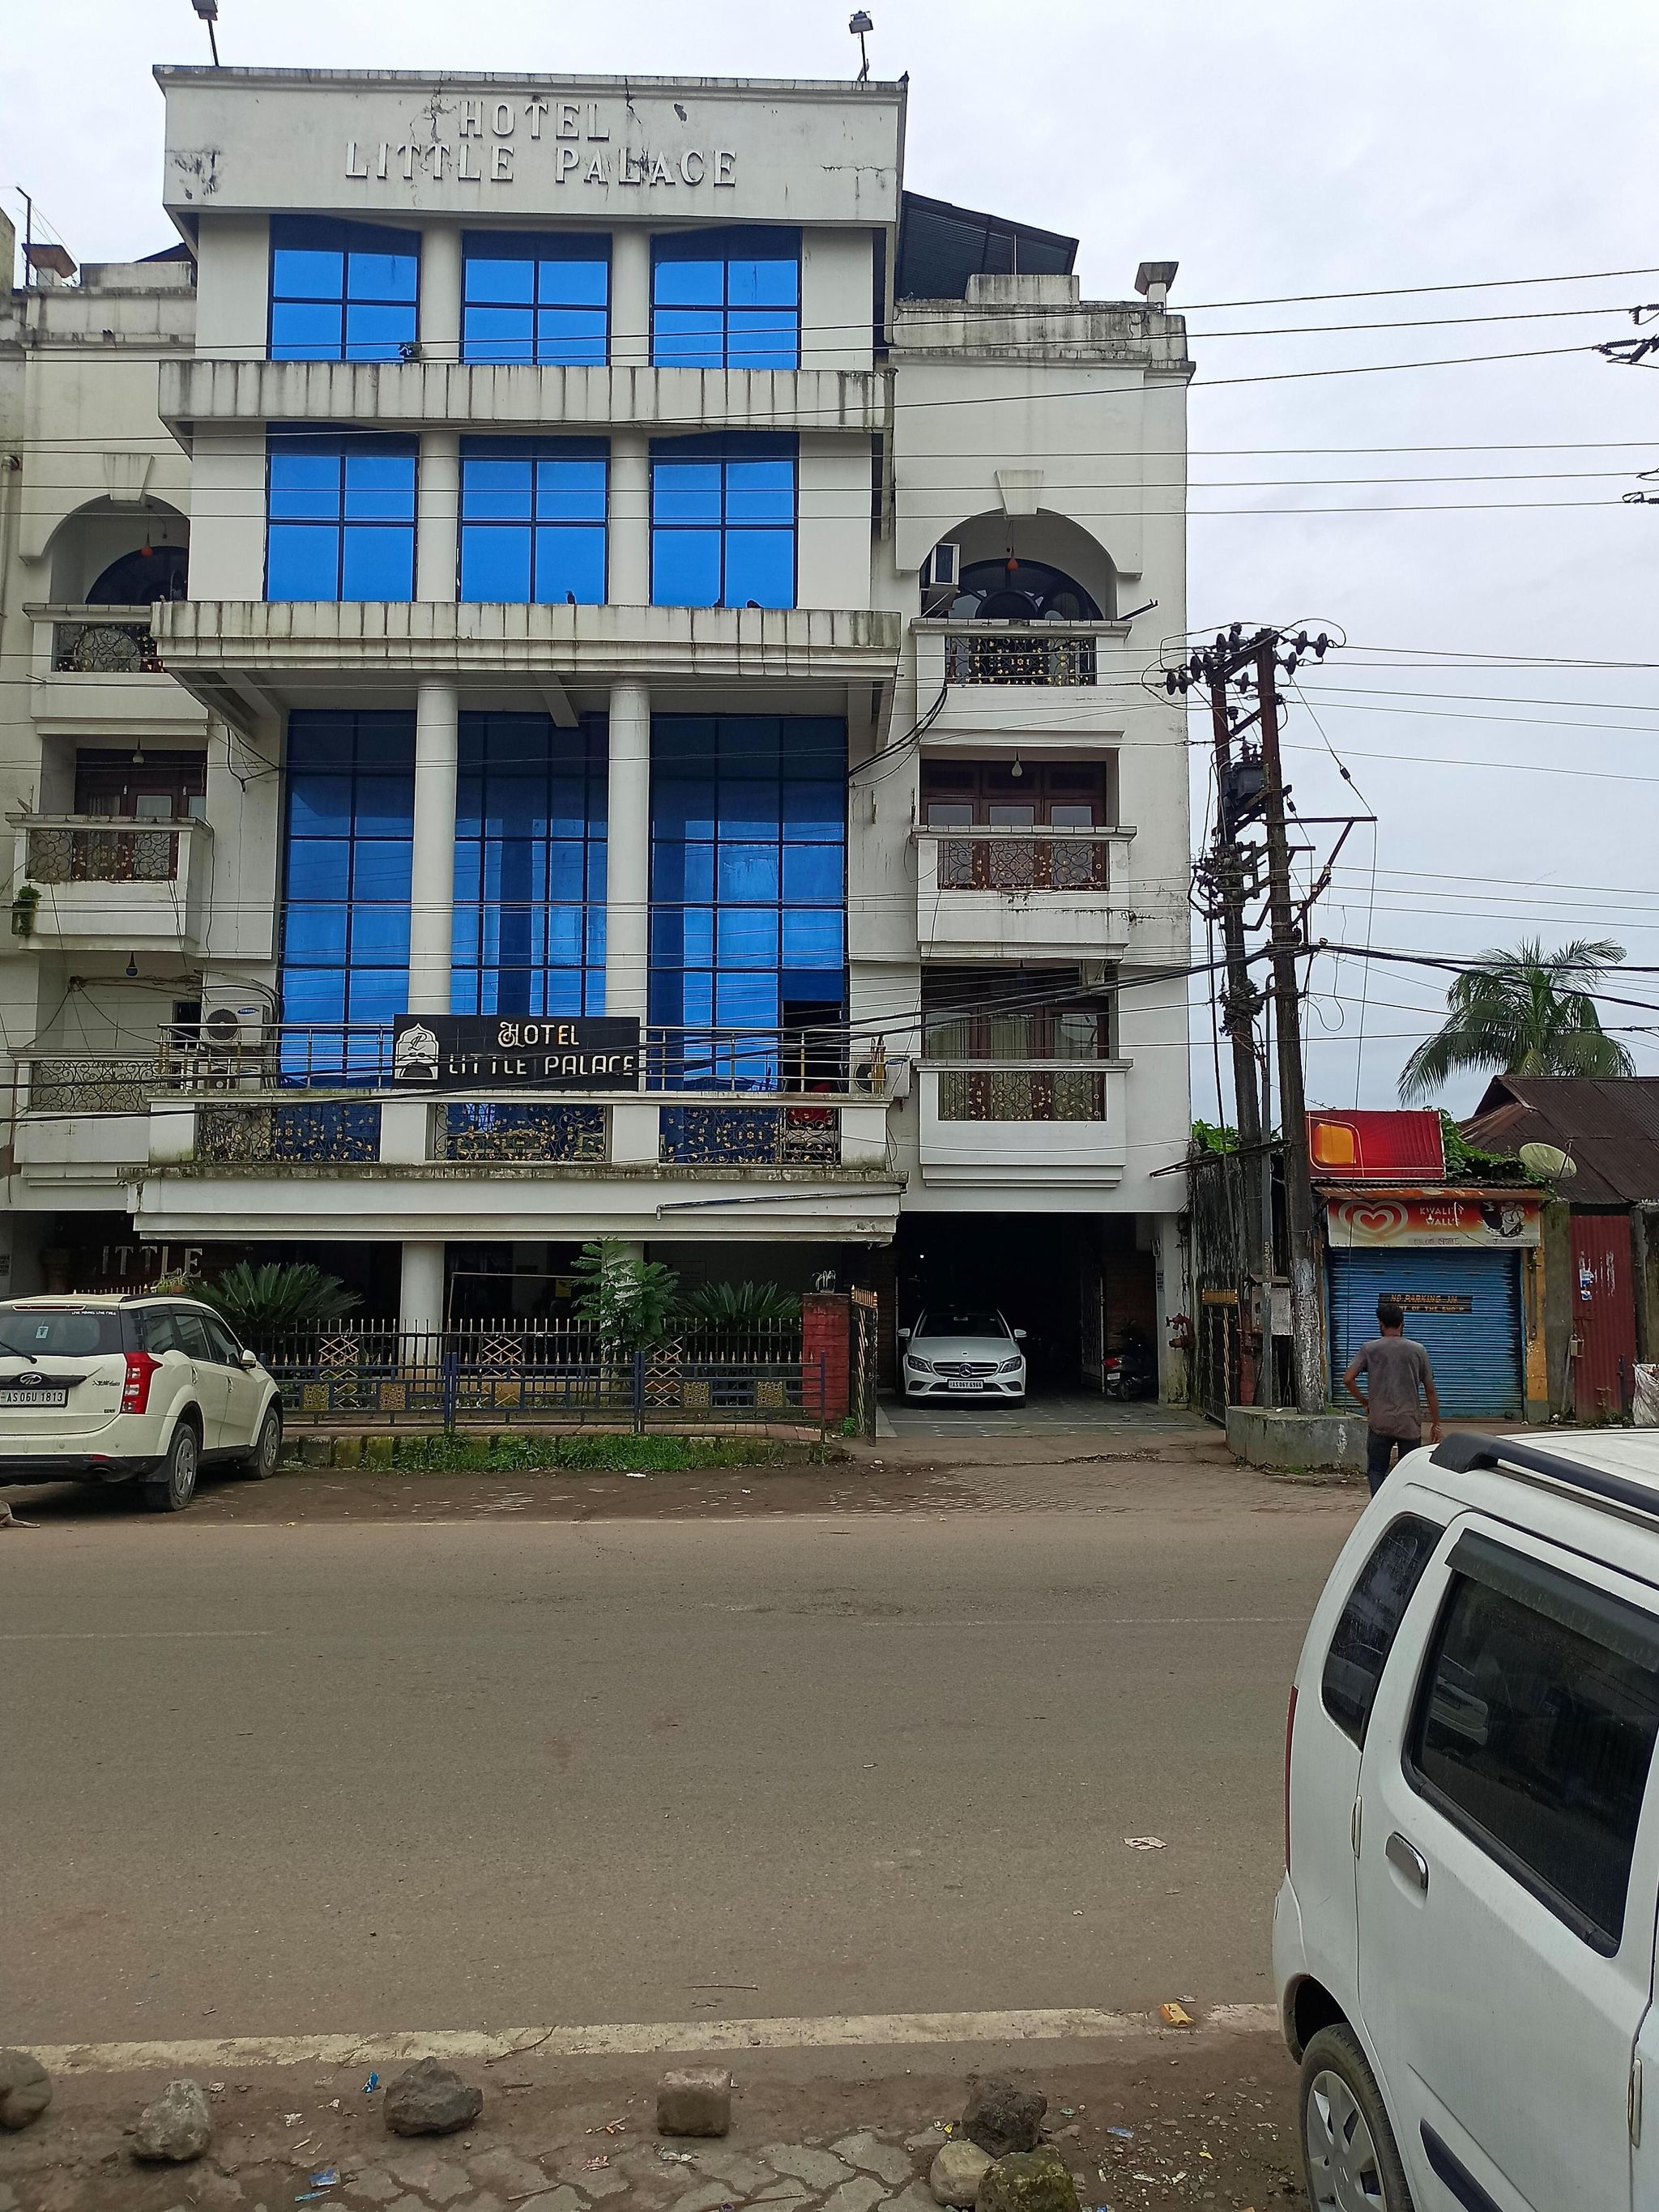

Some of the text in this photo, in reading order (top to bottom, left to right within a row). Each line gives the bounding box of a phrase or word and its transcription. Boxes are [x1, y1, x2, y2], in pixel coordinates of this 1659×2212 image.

[459, 101, 610, 141] HOTEL
[346, 143, 736, 187] LITTLE PALACE
[497, 1021, 580, 1048] HOTEL
[544, 1055, 634, 1076] PALACE
[100, 1246, 203, 1278] ITTLE
[41, 1392, 63, 1402] 1813
